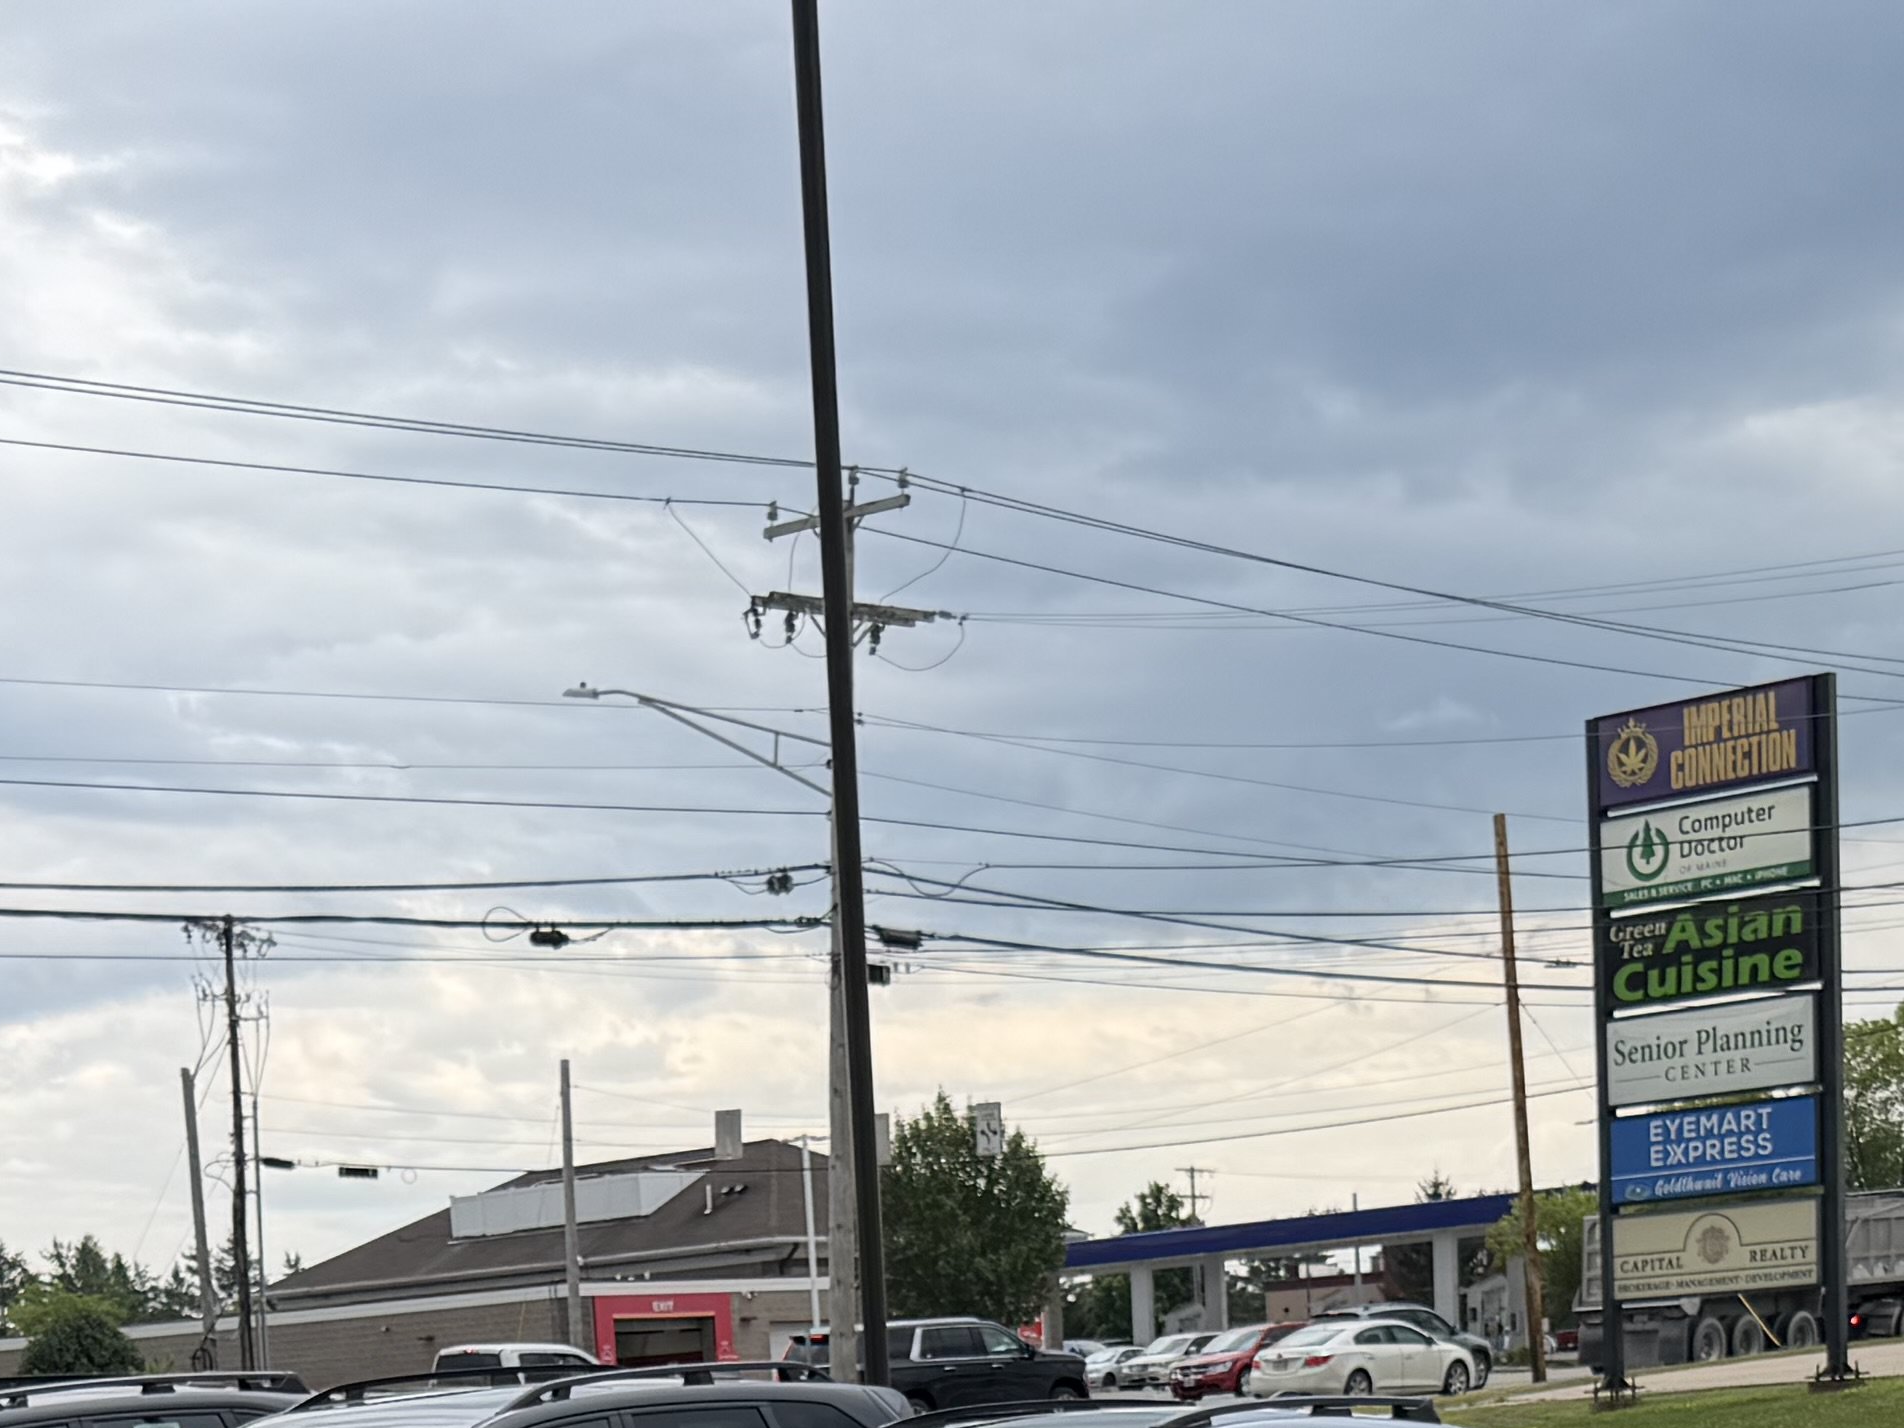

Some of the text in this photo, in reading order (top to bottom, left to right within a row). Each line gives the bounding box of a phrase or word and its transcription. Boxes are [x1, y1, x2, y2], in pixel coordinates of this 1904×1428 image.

[1683, 690, 1779, 746] IMPERIAL
[1670, 729, 1796, 790] CONNECTION
[1678, 804, 1776, 836] Computer
[1679, 835, 1746, 859] Doctor
[1624, 889, 1651, 902] SALES
[1658, 882, 1694, 897] SERVICE
[1700, 879, 1713, 890] PC
[1610, 921, 1667, 942] Green
[1662, 904, 1802, 954] Asian
[1619, 940, 1653, 959] Tea
[1613, 947, 1803, 1002] Cuisine
[1613, 1020, 1804, 1067] Senior Planning
[1664, 1057, 1752, 1082] CENTER
[1649, 1107, 1772, 1143] EYEMART
[1649, 1132, 1773, 1167] EXPRESS
[1727, 1170, 1767, 1188] Vision
[1772, 1167, 1803, 1184] Care
[1620, 1245, 1809, 1274] CAPITAL REALTY
[1675, 1275, 1740, 1289] MANAGEMENT
[1746, 1269, 1814, 1284] DEVELOPMENT
